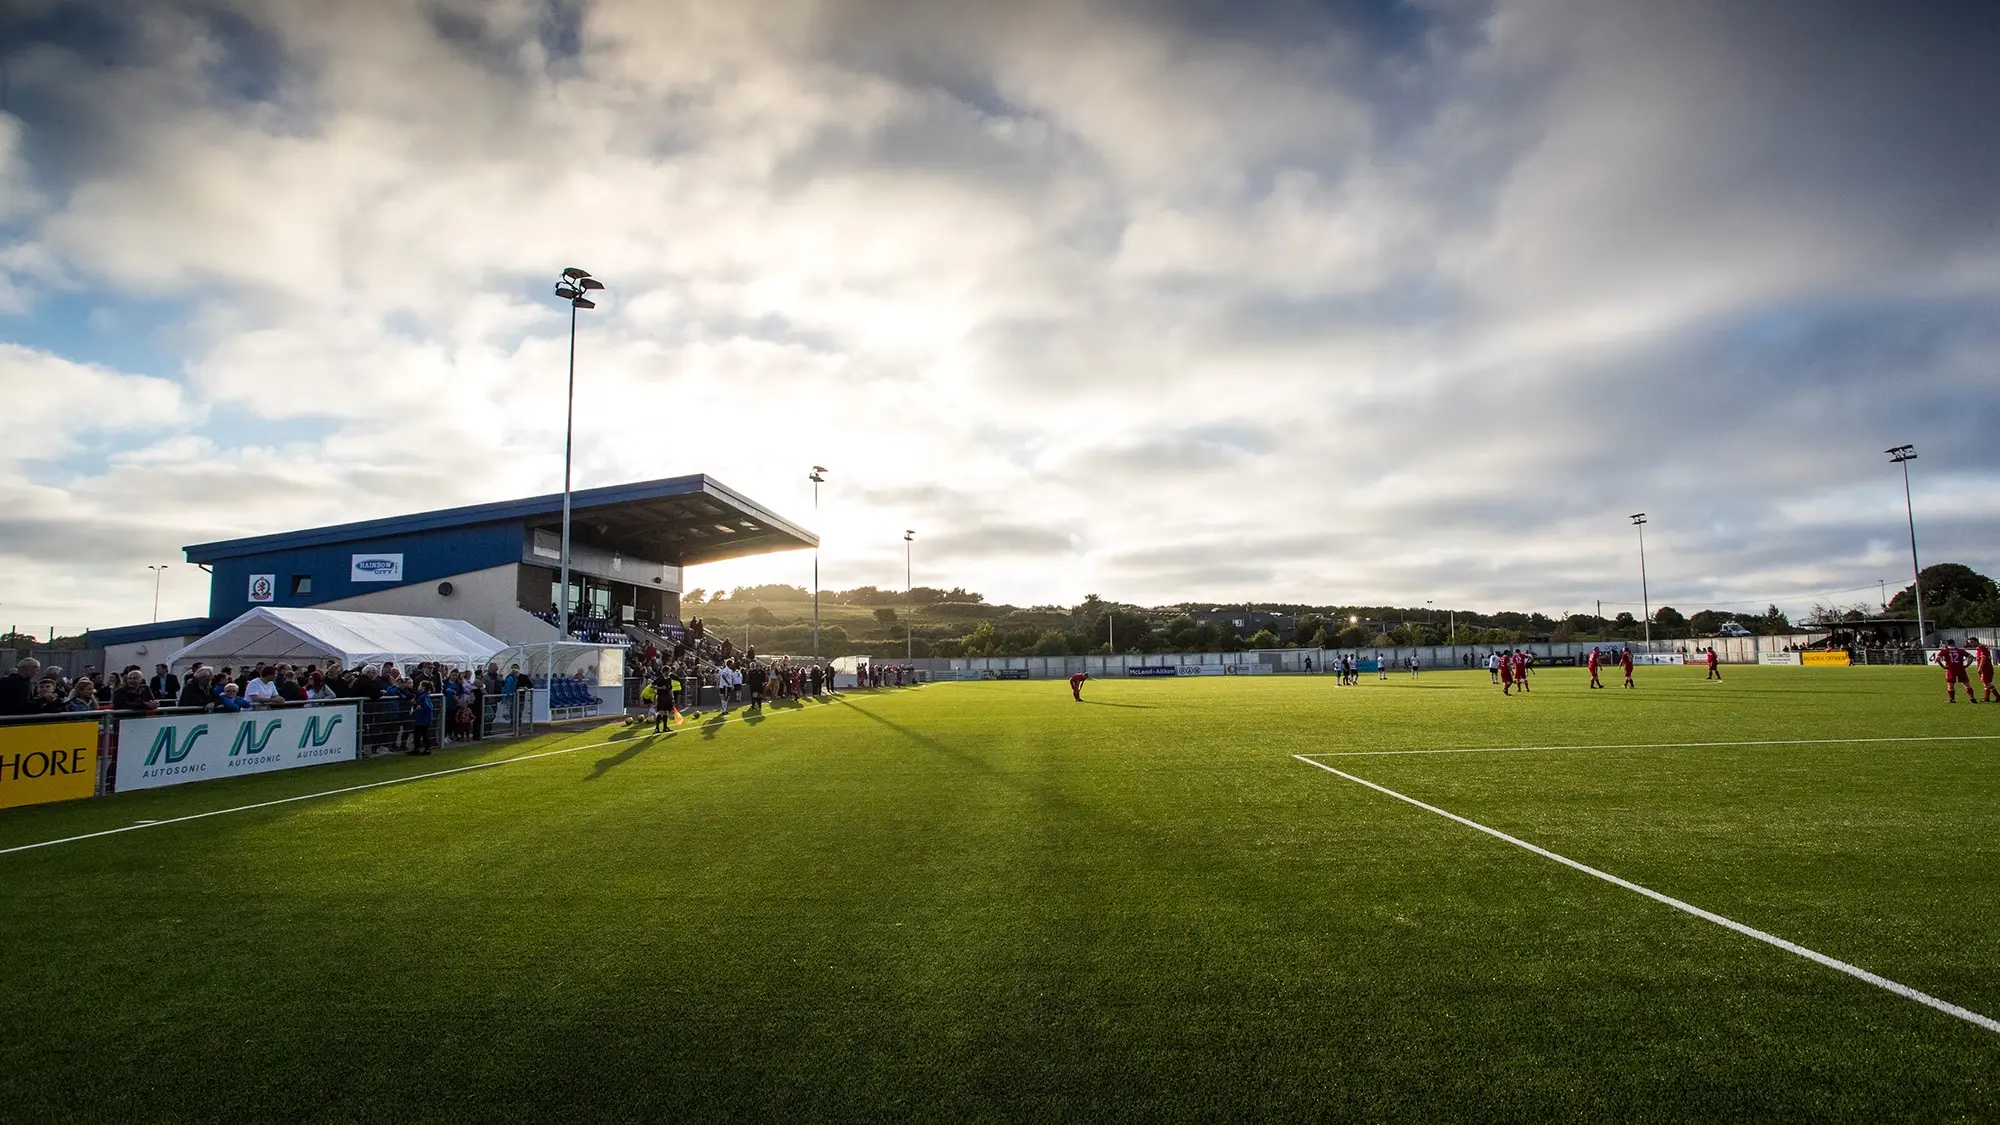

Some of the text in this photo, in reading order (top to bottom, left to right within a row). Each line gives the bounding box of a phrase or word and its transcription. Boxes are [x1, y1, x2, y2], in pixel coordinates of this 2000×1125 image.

[1949, 652, 1959, 663] 12
[296, 747, 342, 759] AUTOSONIC
[0, 747, 87, 782] HORE
[228, 754, 281, 768] AUTOSONIC
[142, 763, 207, 779] AUTOSONIC
